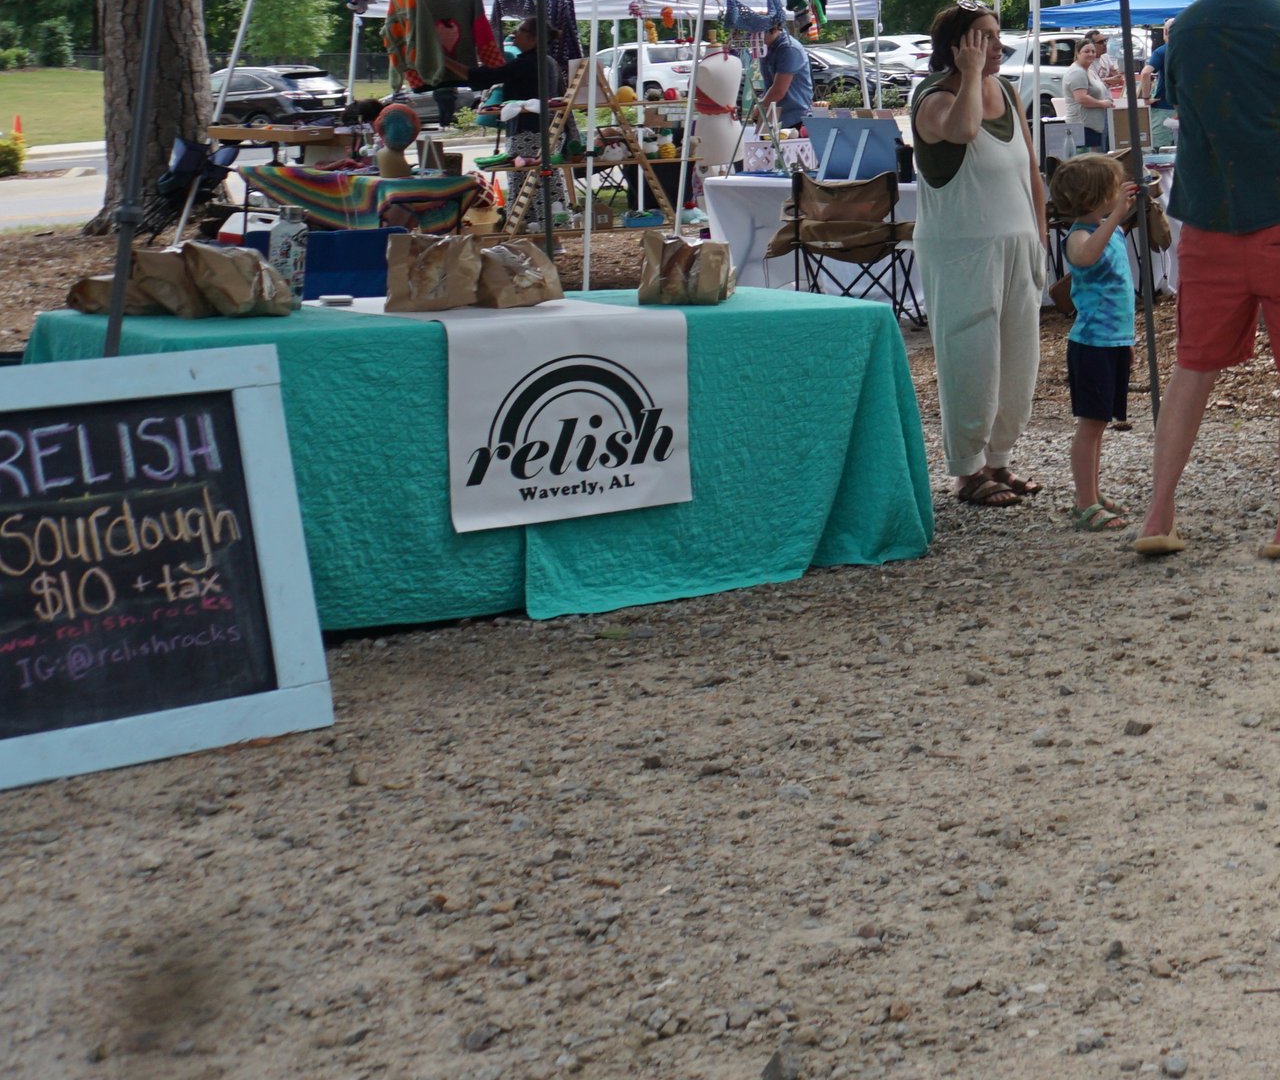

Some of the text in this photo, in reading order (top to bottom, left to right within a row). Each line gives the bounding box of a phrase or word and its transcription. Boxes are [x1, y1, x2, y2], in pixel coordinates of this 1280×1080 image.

[0, 413, 222, 498] RELISH
[466, 408, 674, 487] relish
[519, 474, 636, 501] Waverly, AL
[0, 486, 242, 576] Sourdough
[30, 566, 116, 621] $10
[157, 563, 224, 602] tax
